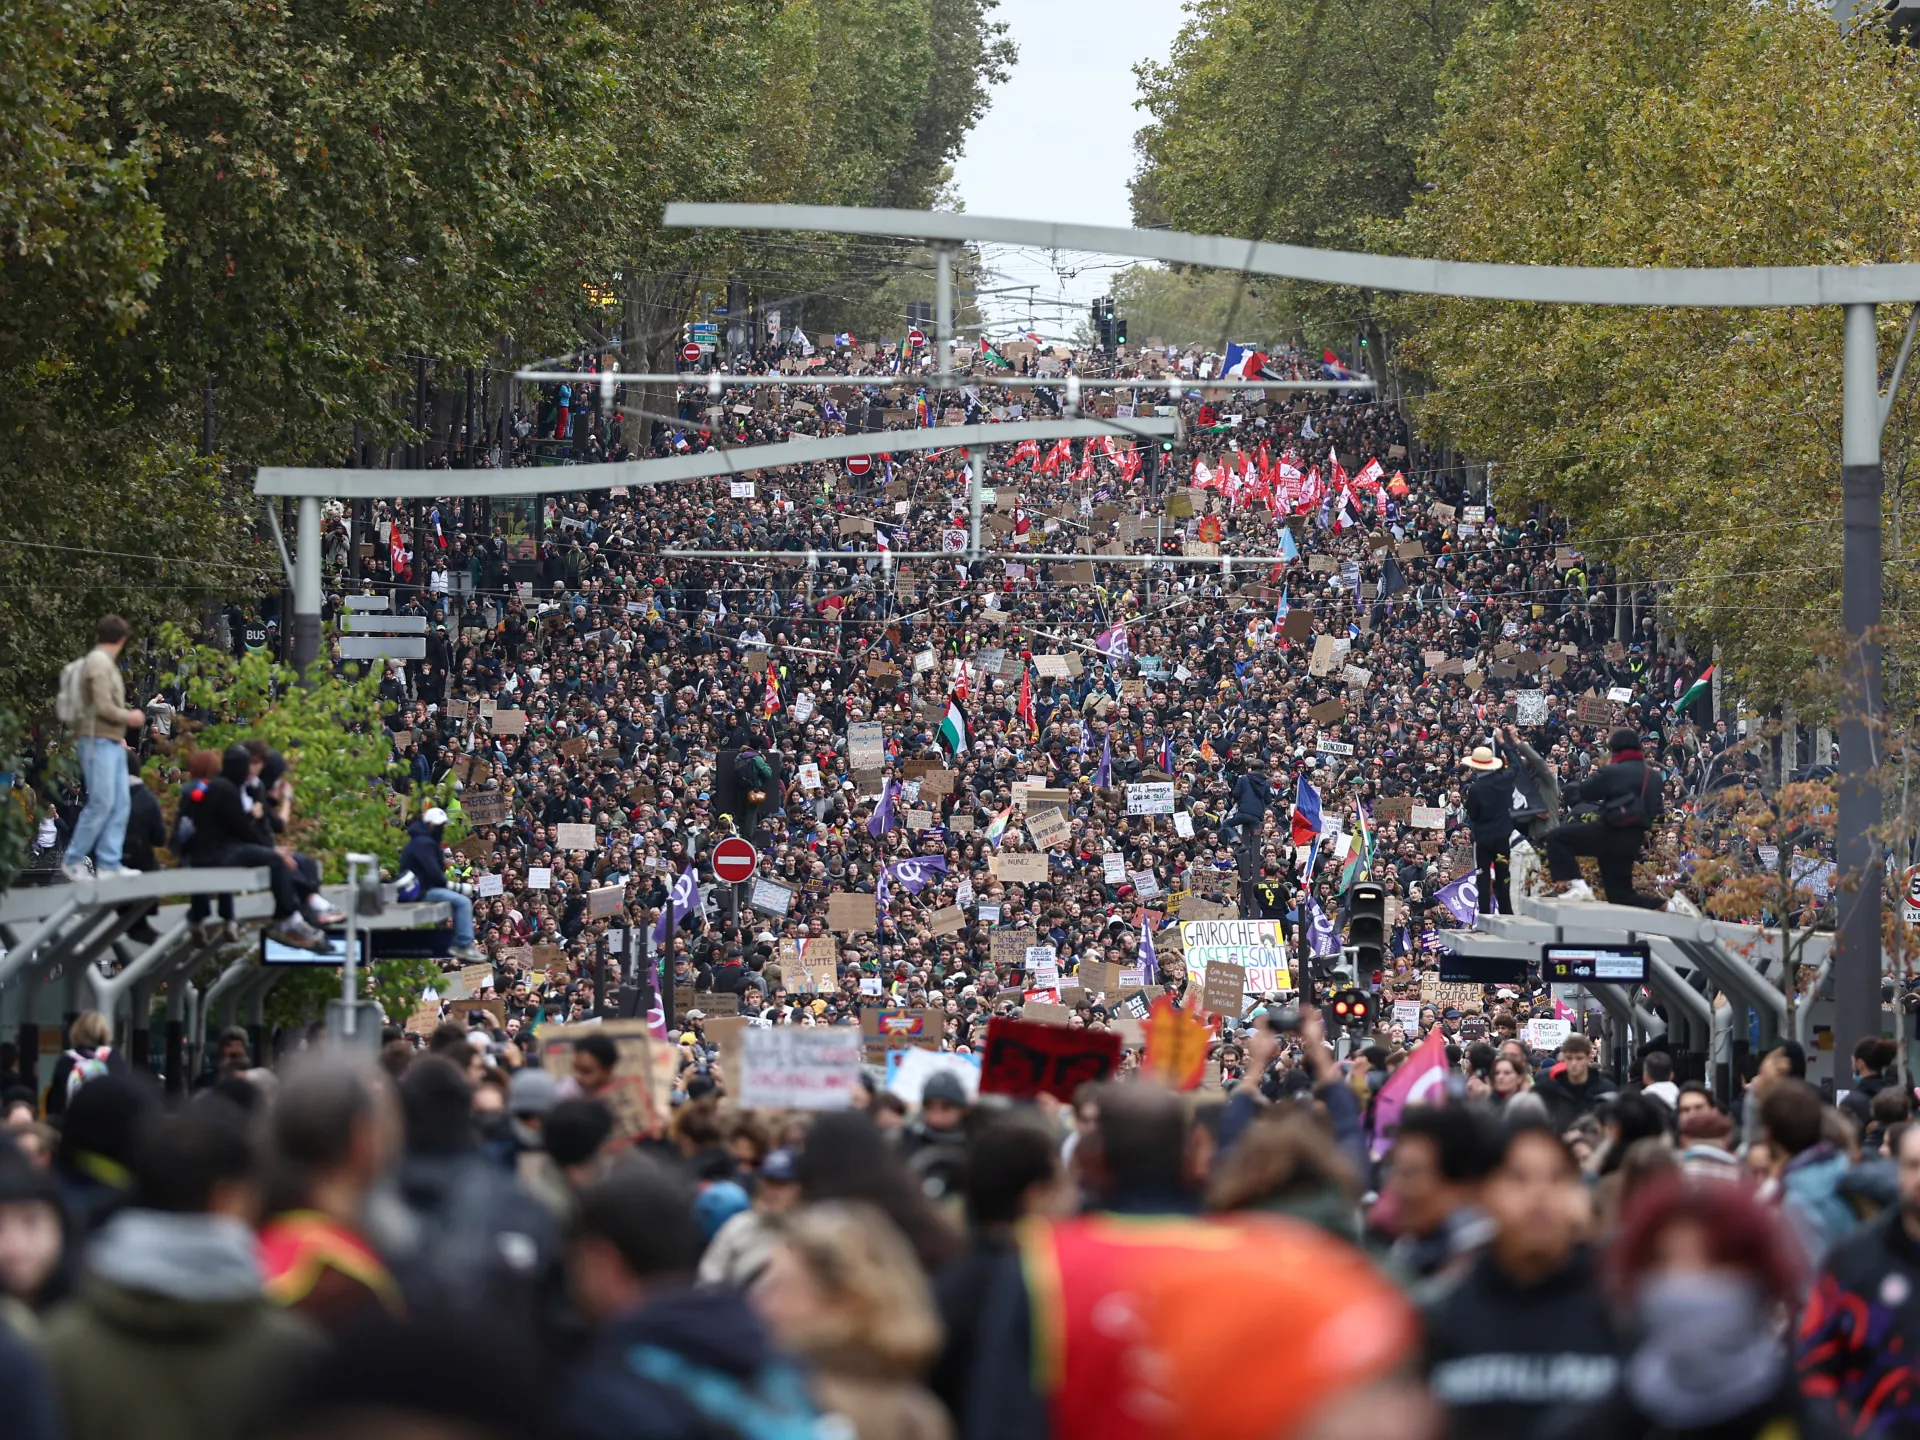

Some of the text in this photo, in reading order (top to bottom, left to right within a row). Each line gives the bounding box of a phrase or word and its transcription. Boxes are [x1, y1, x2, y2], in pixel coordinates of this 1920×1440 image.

[246, 630, 266, 640] BUS
[1323, 742, 1348, 753] BONJOUR
[1265, 889, 1274, 906] 9
[1184, 922, 1258, 947] GAVROCHE
[804, 958, 834, 967] LUTTE
[1555, 964, 1590, 976] 13 +60
[1250, 968, 1290, 992] RUE
[1422, 982, 1438, 991] EST
[1469, 984, 1478, 992] TA
[1436, 1000, 1464, 1011] CHIER
